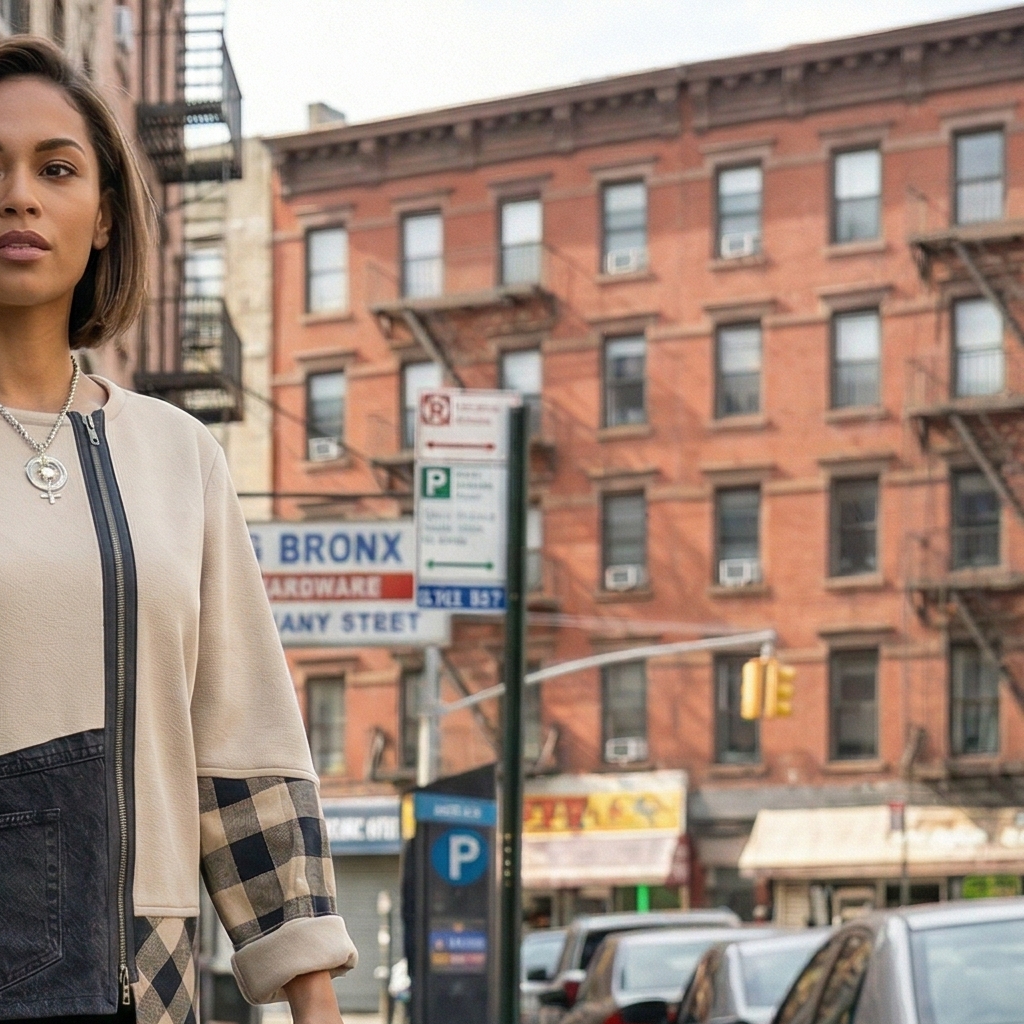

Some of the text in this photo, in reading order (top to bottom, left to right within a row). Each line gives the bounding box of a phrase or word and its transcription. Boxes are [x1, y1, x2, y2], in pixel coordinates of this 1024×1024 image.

[425, 468, 447, 498] P
[279, 532, 402, 564] BRONX
[273, 611, 331, 632] ANY
[448, 834, 481, 881] P
